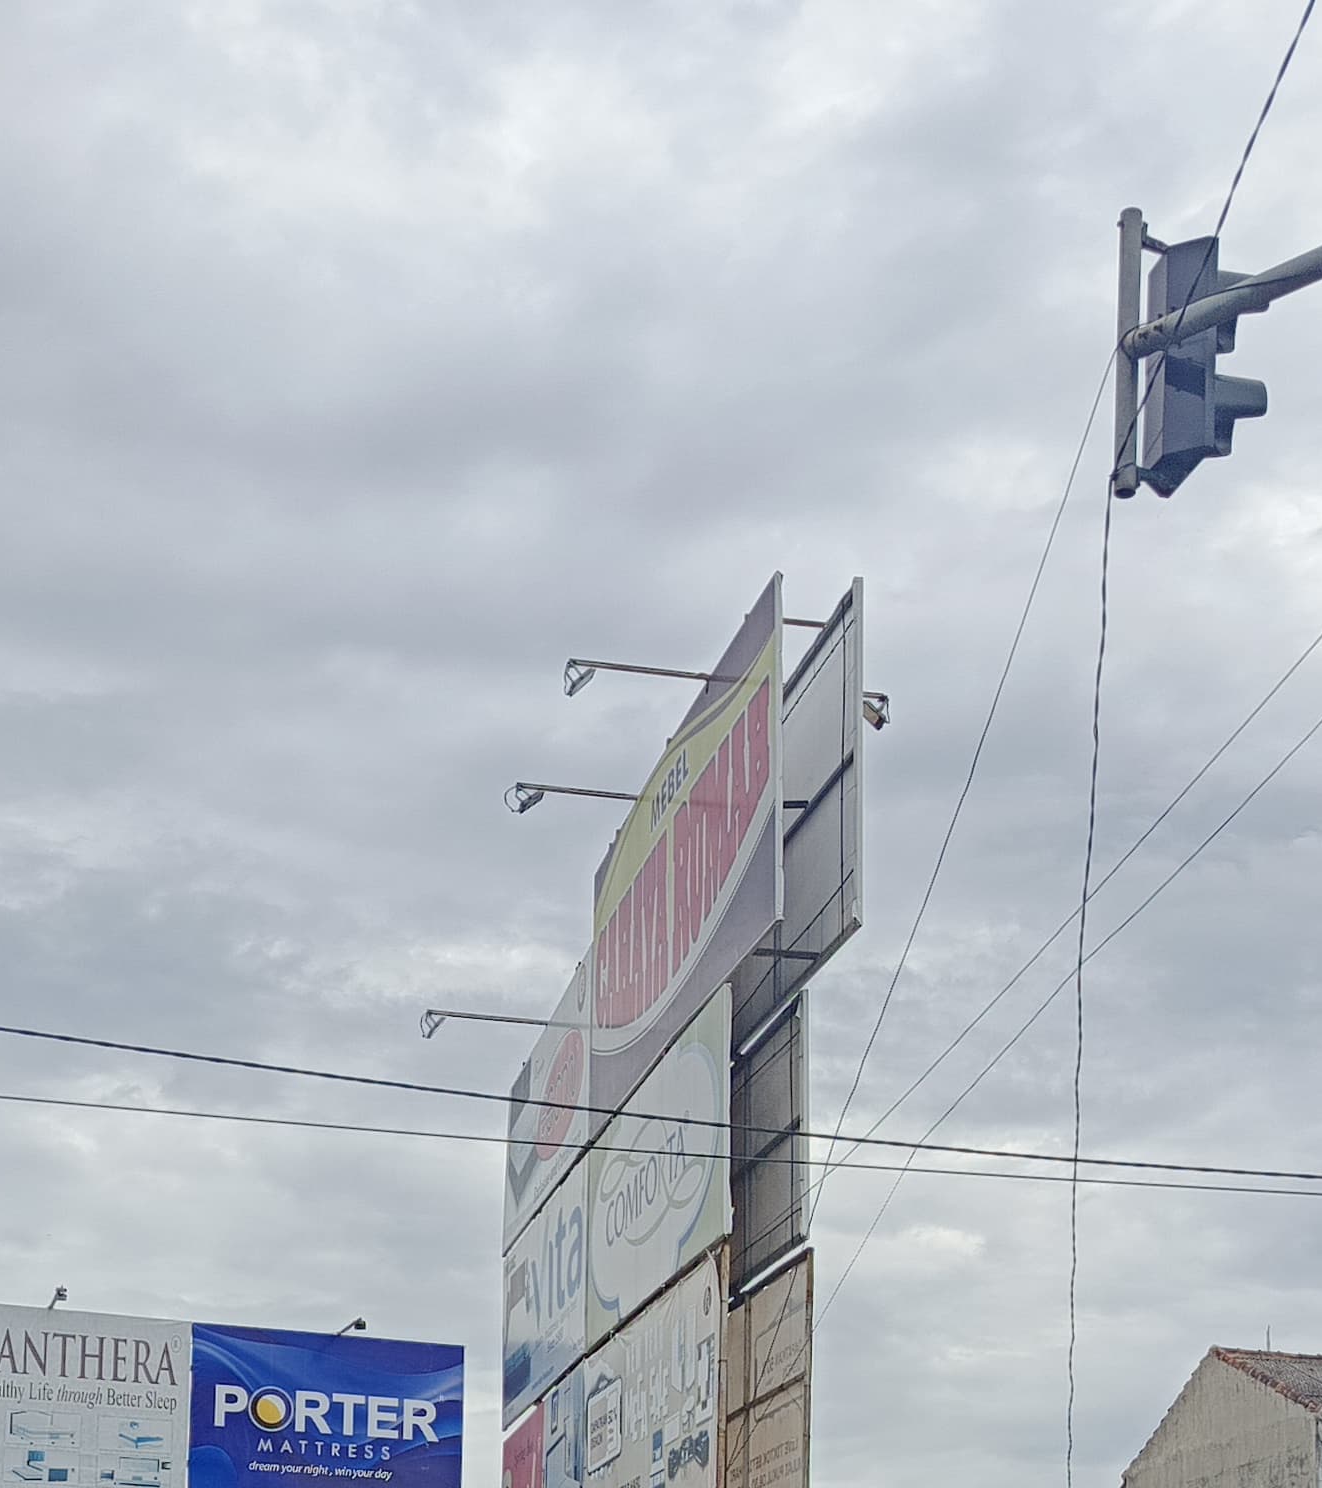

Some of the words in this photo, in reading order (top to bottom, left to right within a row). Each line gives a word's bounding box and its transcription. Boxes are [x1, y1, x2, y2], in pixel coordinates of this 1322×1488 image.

[650, 750, 689, 832] MEBEL
[29, 1382, 54, 1401] Life
[56, 1385, 103, 1409] through
[107, 1390, 143, 1407] Better
[145, 1391, 178, 1414] Sleep
[213, 1383, 439, 1443] PORTER
[257, 1438, 391, 1461] MATTRESS
[248, 1460, 280, 1473] dream
[280, 1464, 303, 1475] your
[334, 1468, 352, 1478] win
[352, 1468, 374, 1480] your
[374, 1469, 393, 1481] day
